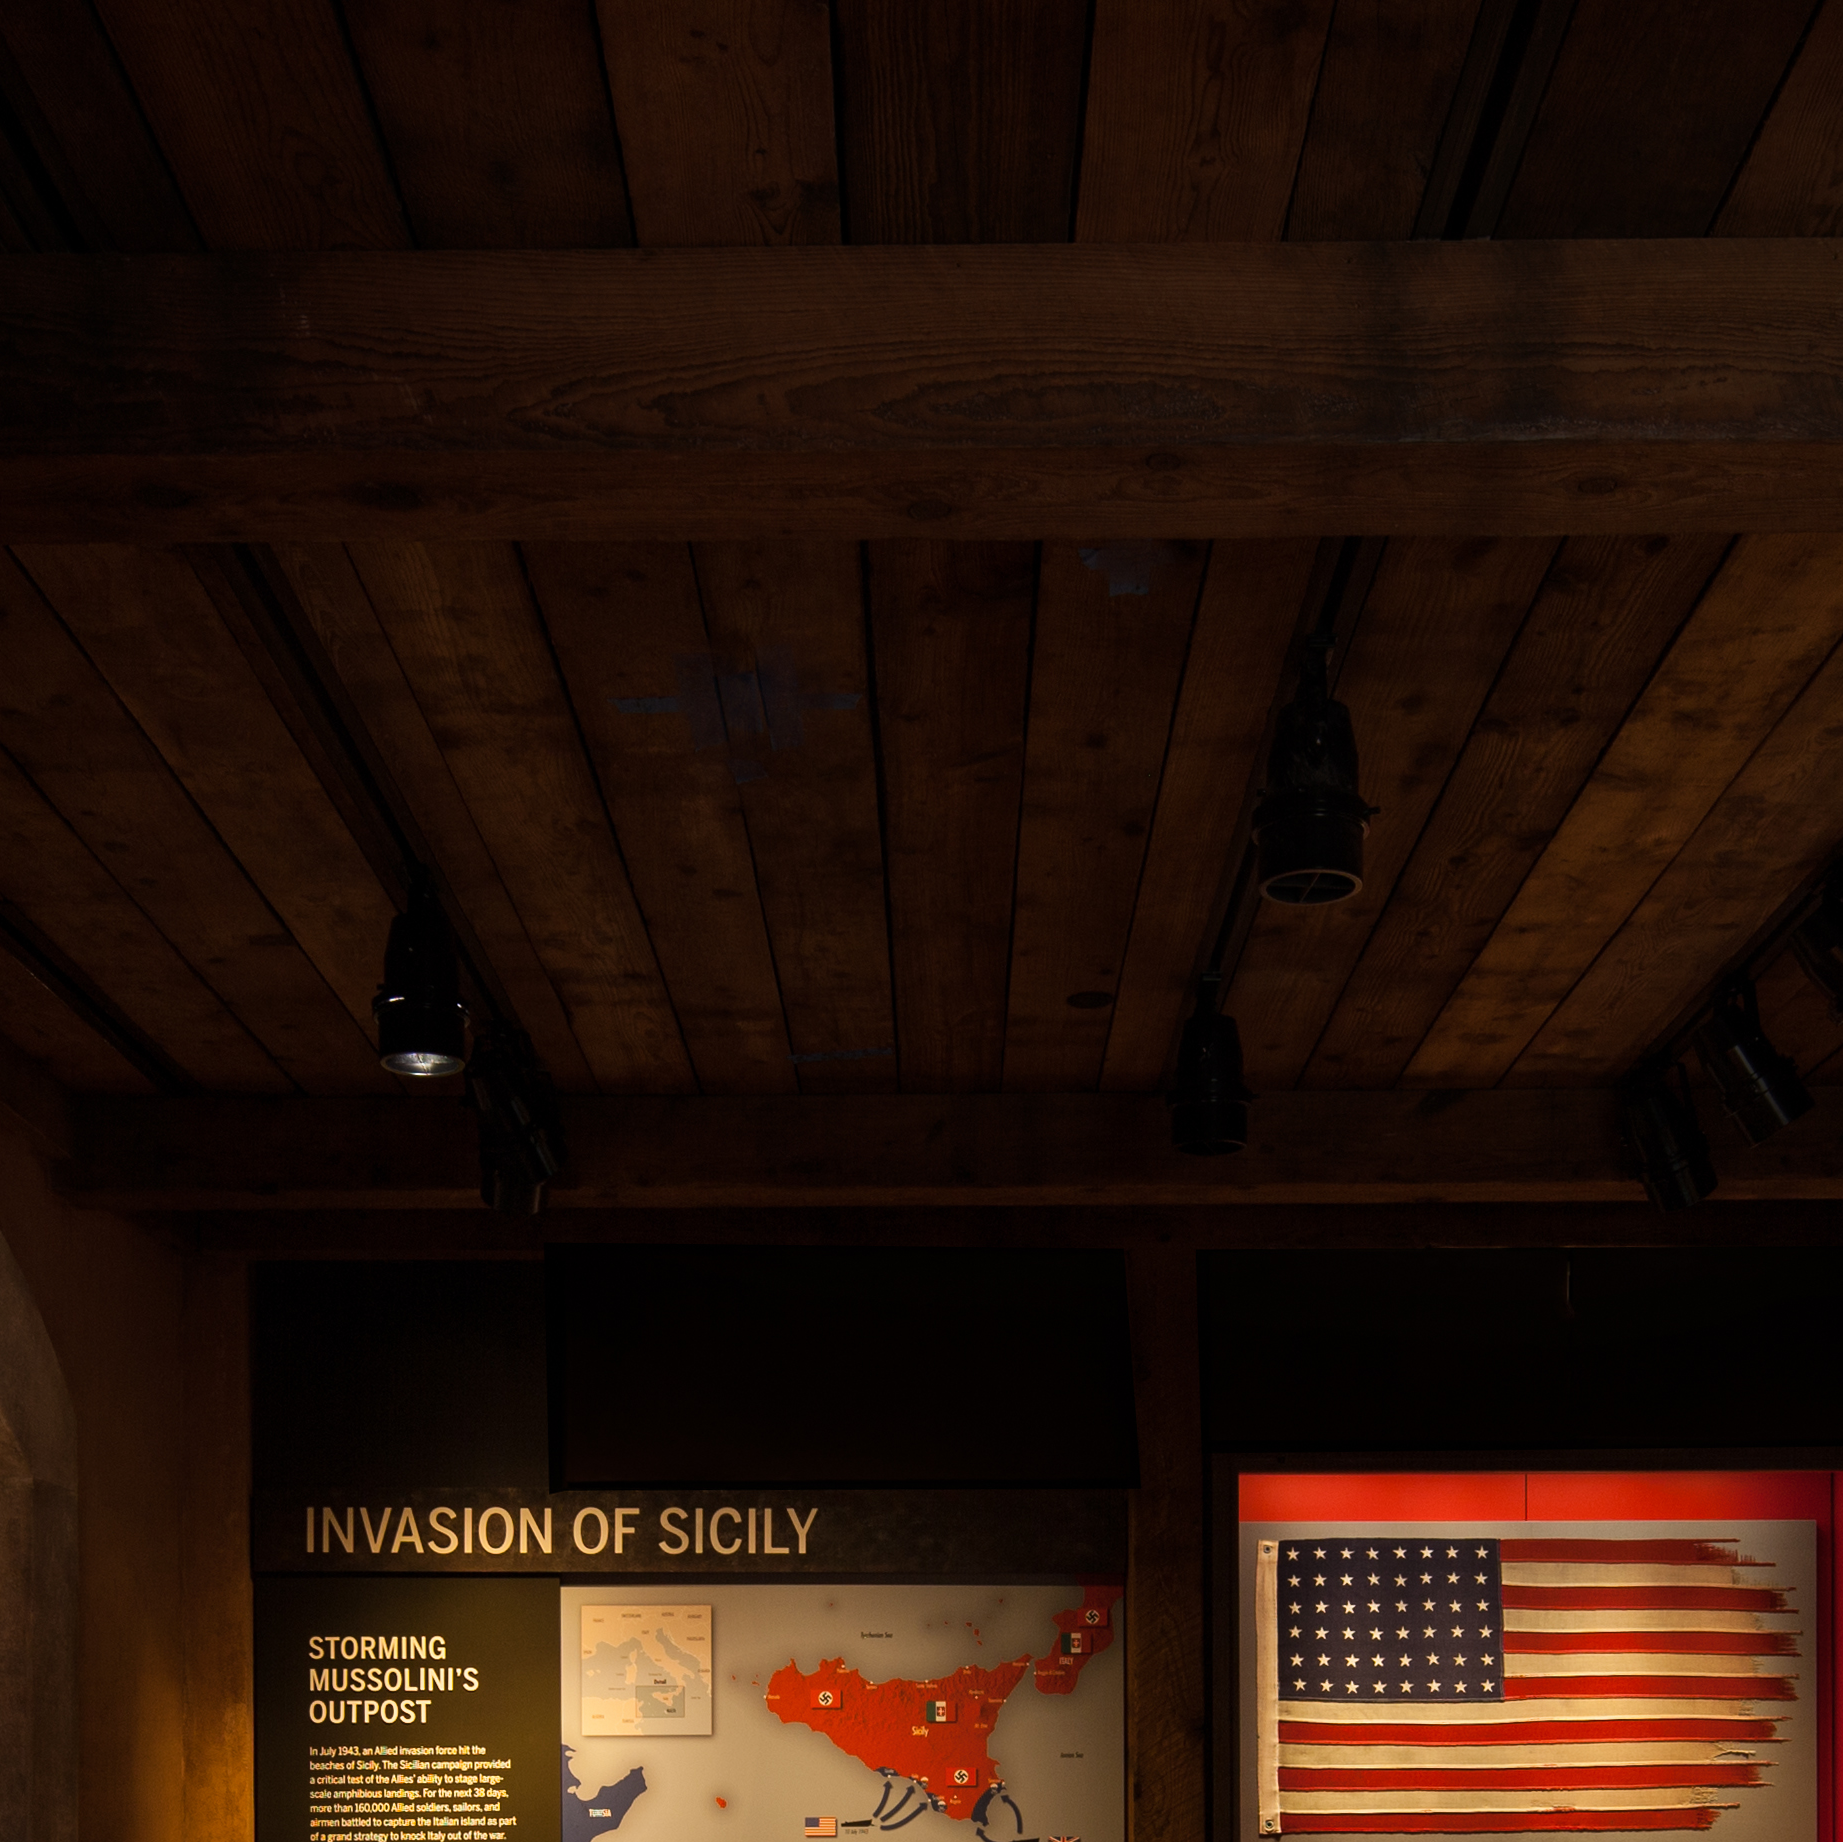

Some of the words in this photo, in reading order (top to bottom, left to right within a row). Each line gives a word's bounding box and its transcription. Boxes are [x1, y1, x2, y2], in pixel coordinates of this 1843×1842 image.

[305, 1506, 553, 1554] INVASION
[573, 1506, 641, 1555] OF
[658, 1506, 819, 1555] SICILY
[309, 1636, 447, 1660] STORMING
[1059, 1656, 1074, 1665] ITALY
[309, 1667, 479, 1692] MUSSOLINI'S
[309, 1699, 432, 1724] OUTPOST
[912, 1726, 929, 1738] Sicily
[310, 1745, 317, 1755] In
[319, 1745, 336, 1757] July
[338, 1745, 360, 1756] 1943,
[374, 1745, 397, 1755] Allied
[399, 1745, 433, 1755] invasion
[435, 1745, 457, 1755] force
[459, 1745, 470, 1755] hit
[472, 1744, 486, 1754] the
[310, 1760, 344, 1770] beaches
[346, 1760, 354, 1770] of
[356, 1759, 380, 1772] Sicily.
[382, 1759, 397, 1769] The
[399, 1759, 429, 1769] Sicilian
[431, 1759, 472, 1771] campaign
[474, 1758, 511, 1771] provided
[317, 1774, 345, 1784] critical
[347, 1774, 363, 1784] test
[365, 1774, 373, 1784] of
[375, 1774, 389, 1784] the
[391, 1774, 415, 1784] Allies'
[417, 1774, 442, 1786] ability
[444, 1773, 453, 1783] to
[455, 1773, 477, 1785] stage
[479, 1773, 504, 1785] large-
[310, 1788, 331, 1798] scale
[333, 1788, 382, 1800] amphibious
[384, 1788, 421, 1800] landings.
[423, 1788, 436, 1798] For
[438, 1788, 452, 1798] the
[454, 1788, 471, 1798] next
[473, 1788, 484, 1798] 38
[486, 1787, 508, 1800] days,
[310, 1805, 331, 1813] more
[333, 1802, 353, 1812] than
[355, 1802, 389, 1813] 160,000
[391, 1802, 414, 1812] Allied
[416, 1802, 451, 1813] soldiers,
[453, 1802, 482, 1813] sailors,
[484, 1802, 500, 1812] and
[589, 1809, 612, 1817] TUNISIA
[310, 1817, 339, 1827] airmen
[341, 1817, 370, 1827] battled
[372, 1817, 381, 1827] to
[383, 1816, 415, 1829] capture
[417, 1816, 431, 1826] the
[433, 1816, 458, 1826] Italian
[460, 1816, 485, 1826] island
[499, 1816, 517, 1828] part
[310, 1831, 318, 1841] of
[327, 1831, 351, 1842] grand
[353, 1831, 388, 1842] strategy
[390, 1831, 398, 1841] to
[400, 1831, 425, 1841] knock
[427, 1831, 445, 1842] Italy
[447, 1830, 461, 1840] out
[463, 1830, 471, 1840] of
[473, 1830, 487, 1840] the
